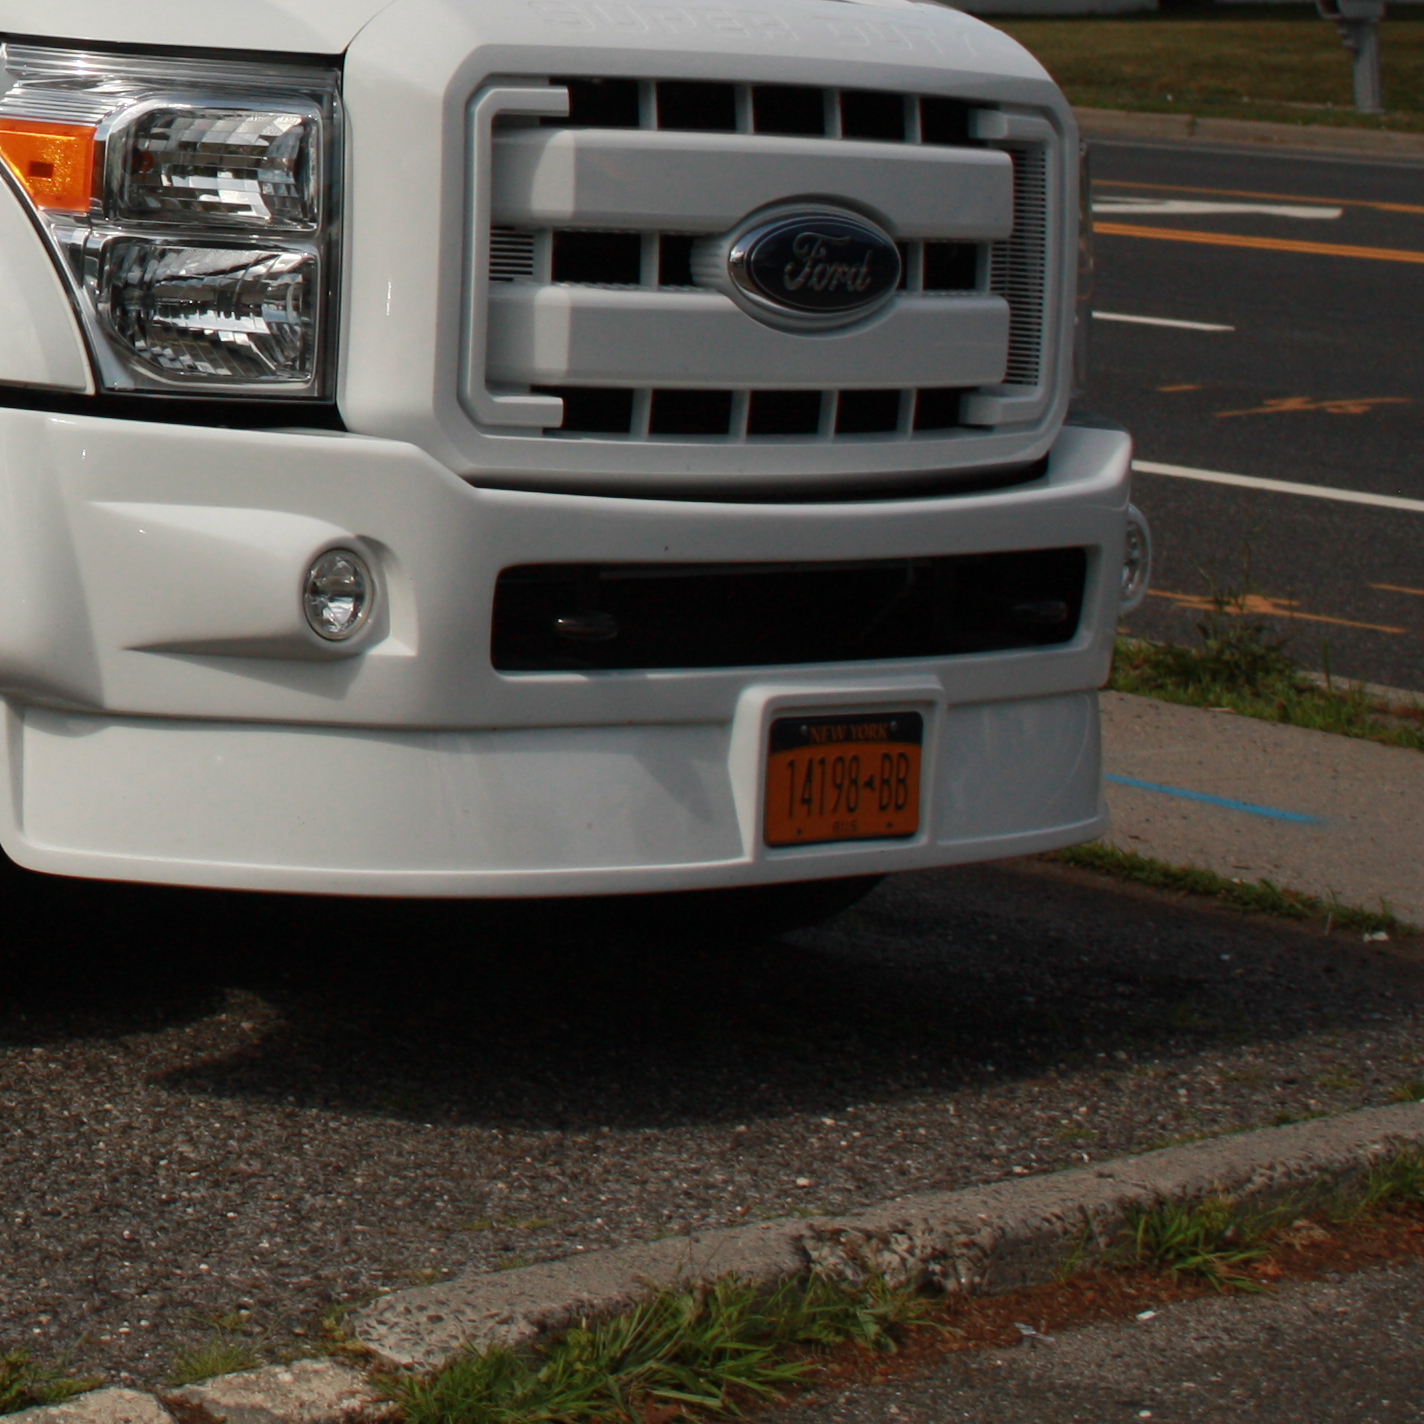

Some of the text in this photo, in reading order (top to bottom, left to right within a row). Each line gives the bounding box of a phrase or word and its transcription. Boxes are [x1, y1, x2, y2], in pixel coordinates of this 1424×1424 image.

[782, 231, 874, 292] Ford
[809, 721, 889, 744] NEW YORK
